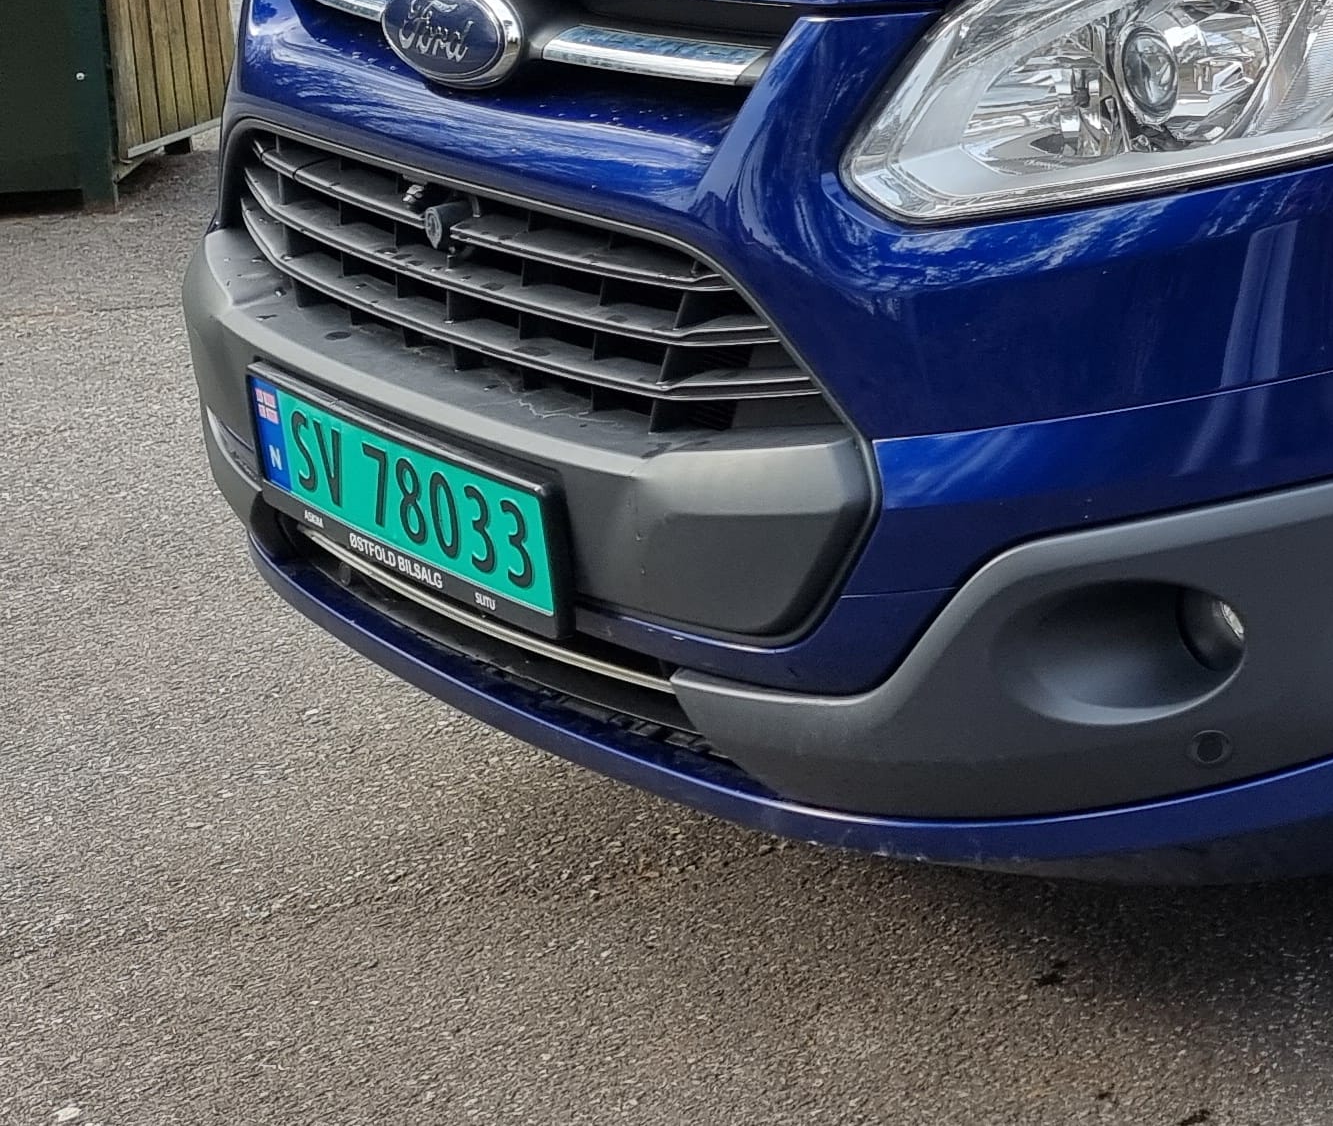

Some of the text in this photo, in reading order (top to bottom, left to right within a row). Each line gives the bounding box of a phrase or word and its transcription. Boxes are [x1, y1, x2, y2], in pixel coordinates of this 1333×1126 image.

[268, 444, 283, 471] N
[291, 410, 535, 590] SV 78033
[349, 532, 444, 589] ØSTFOLD BILSALG
